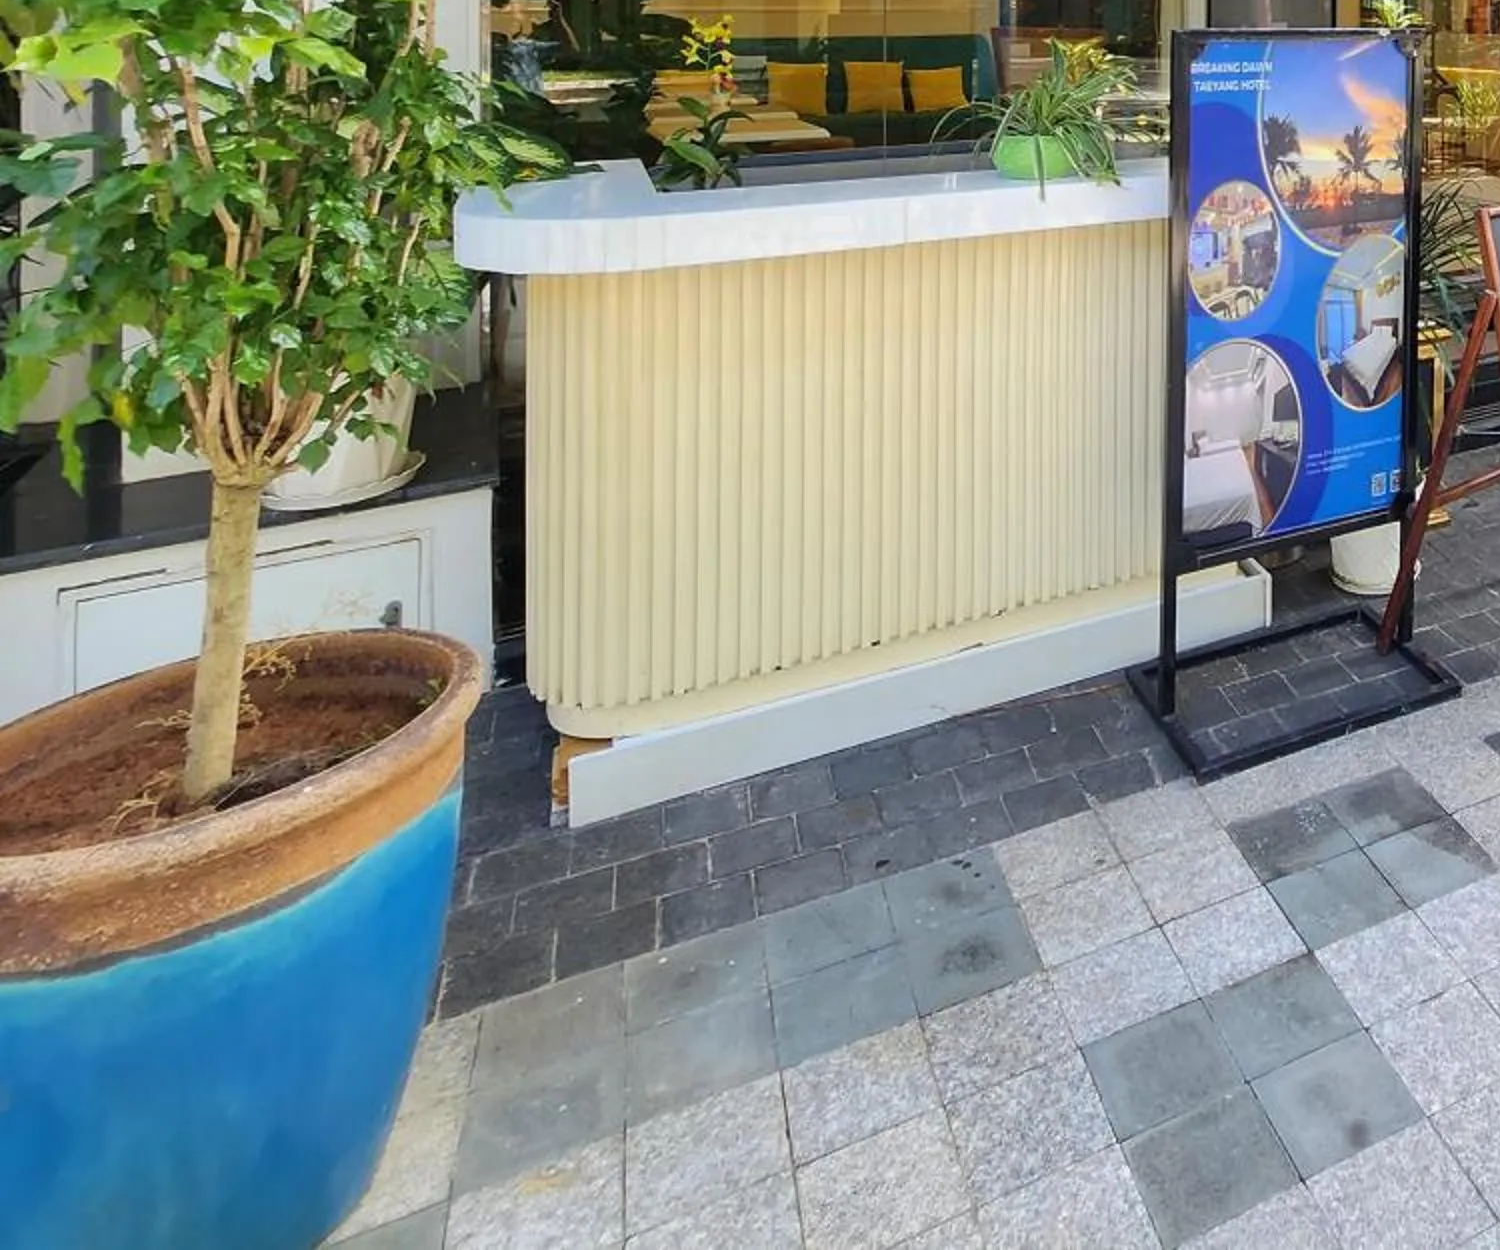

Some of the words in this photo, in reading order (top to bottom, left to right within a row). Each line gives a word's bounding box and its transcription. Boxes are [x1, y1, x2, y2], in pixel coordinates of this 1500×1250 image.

[1191, 61, 1240, 74] BREAKING
[1241, 61, 1273, 73] DAWN
[1193, 80, 1240, 93] TAEYANG
[1241, 79, 1271, 91] HOTEL
